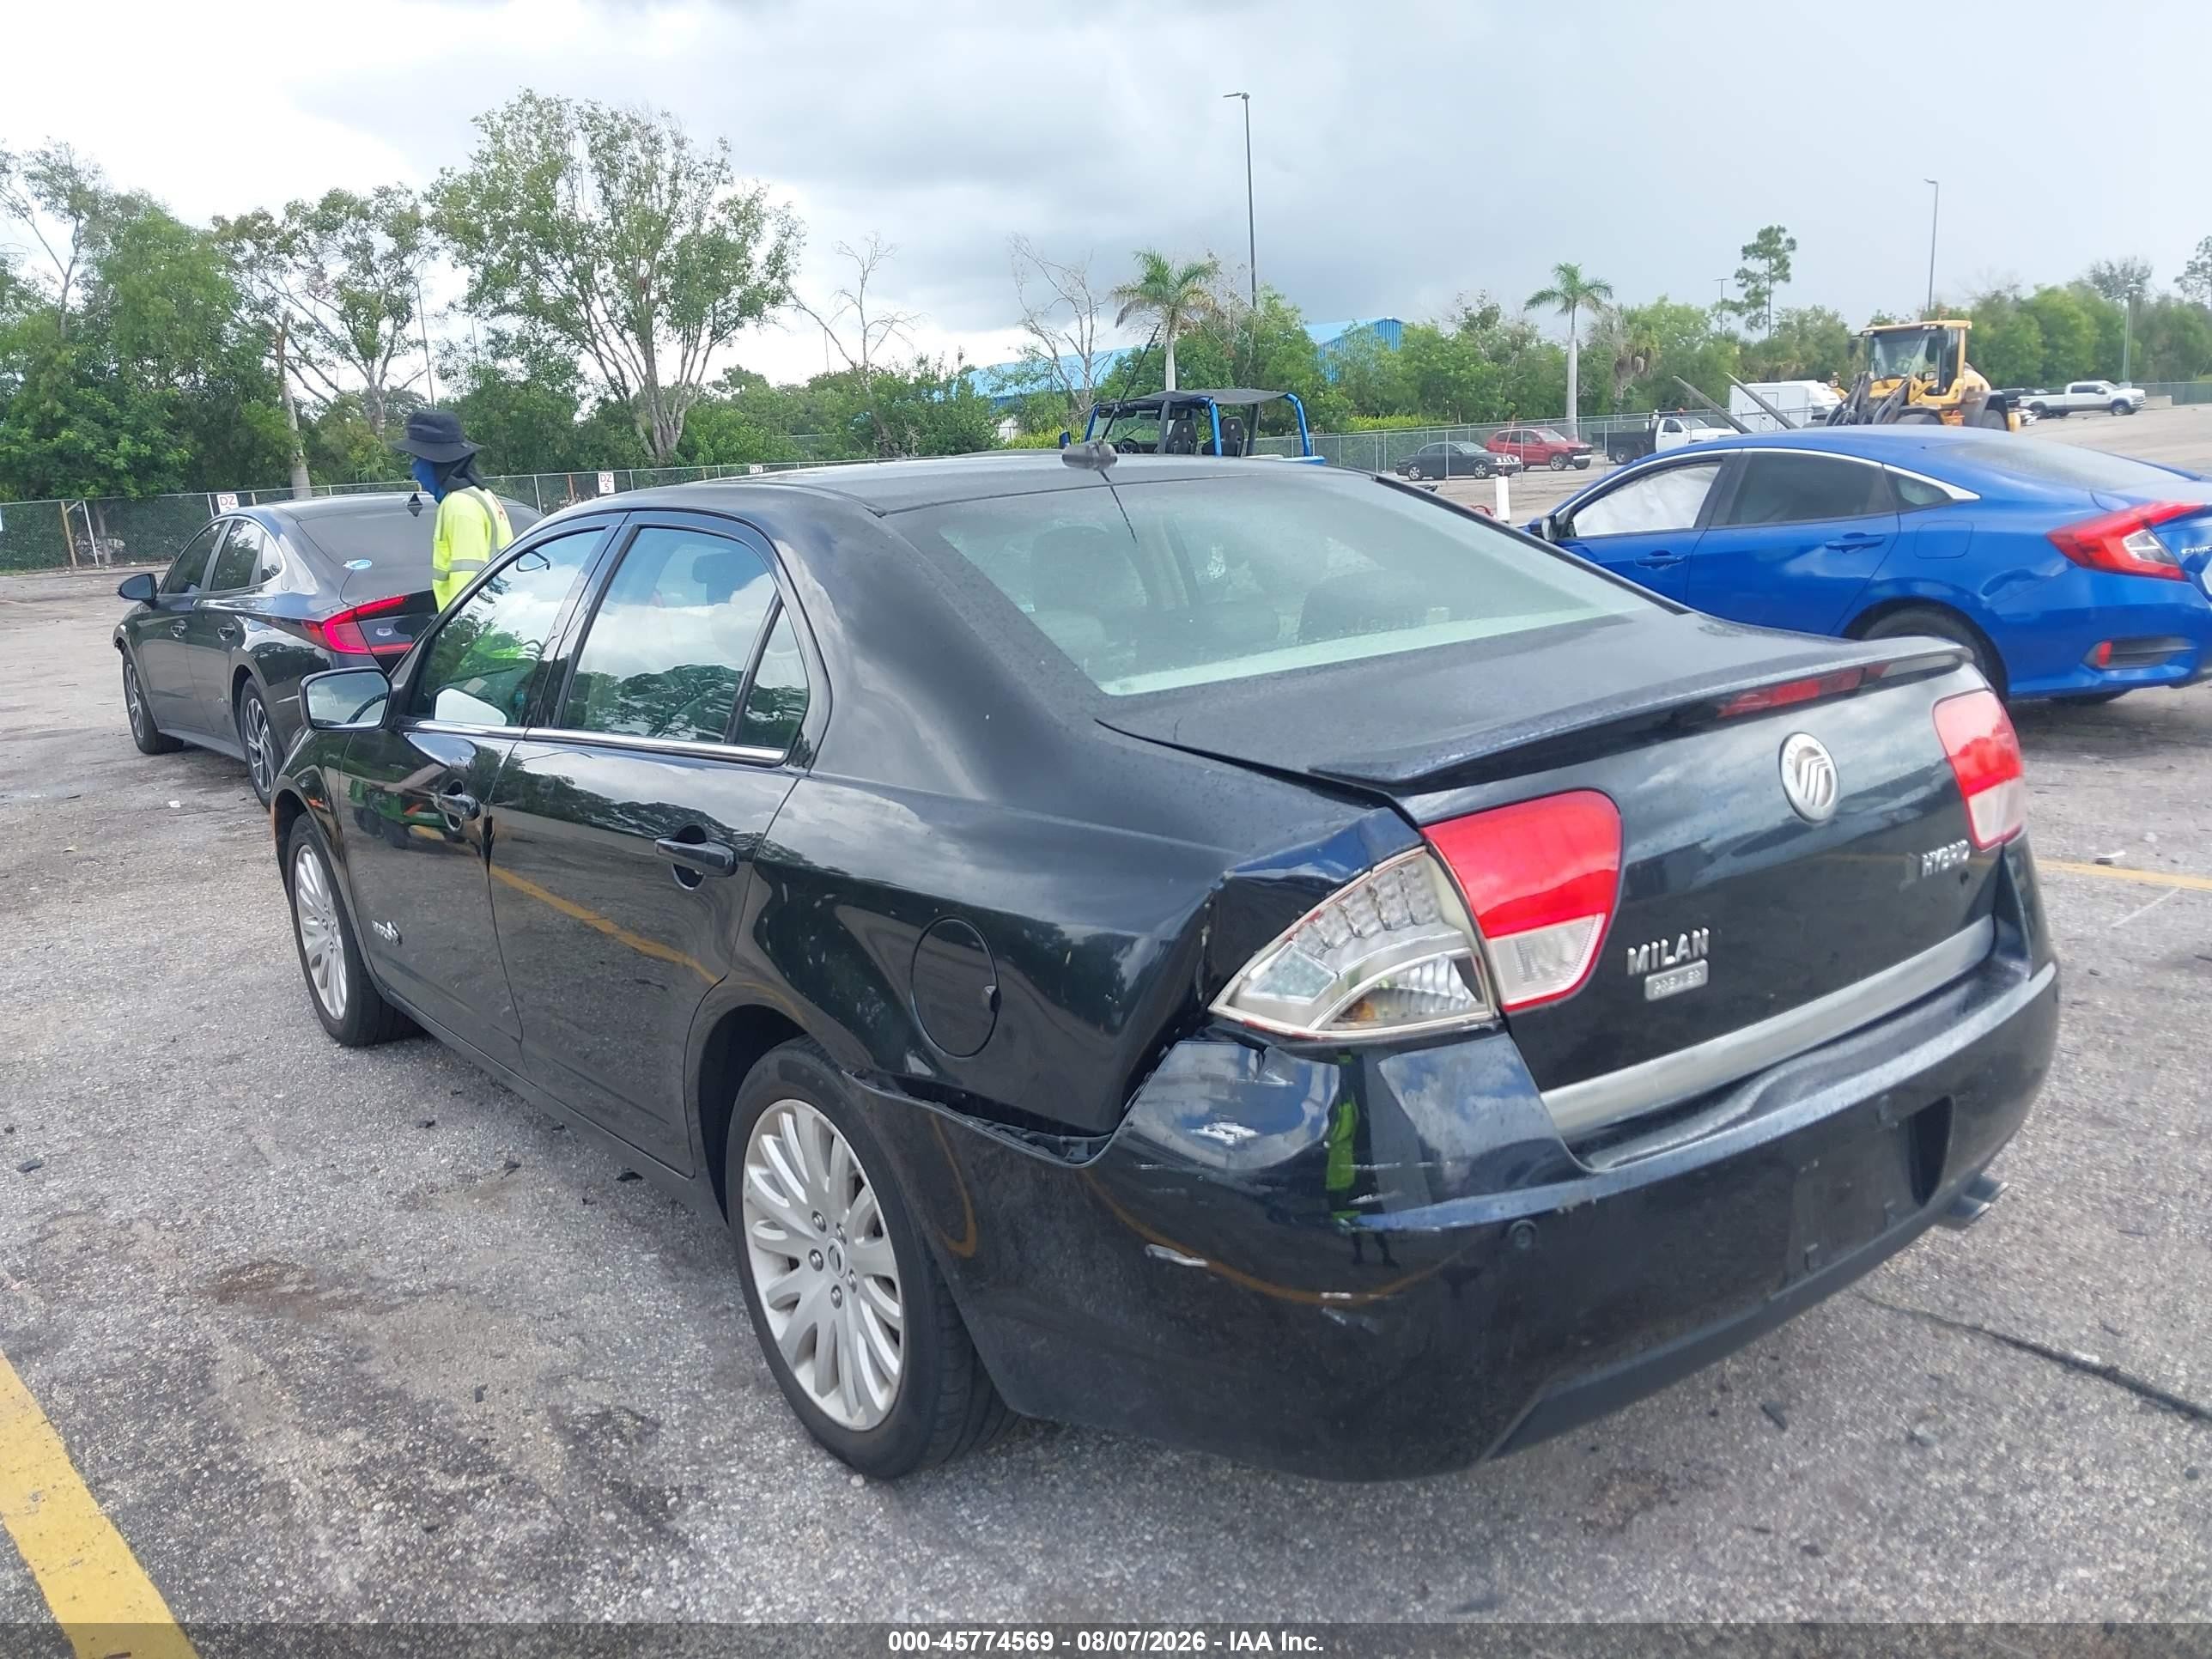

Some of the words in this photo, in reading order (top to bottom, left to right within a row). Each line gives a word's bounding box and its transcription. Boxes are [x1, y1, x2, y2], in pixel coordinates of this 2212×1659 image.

[599, 473, 612, 483] DZ
[219, 495, 236, 506] DZ
[1627, 927, 1710, 976] MILAN
